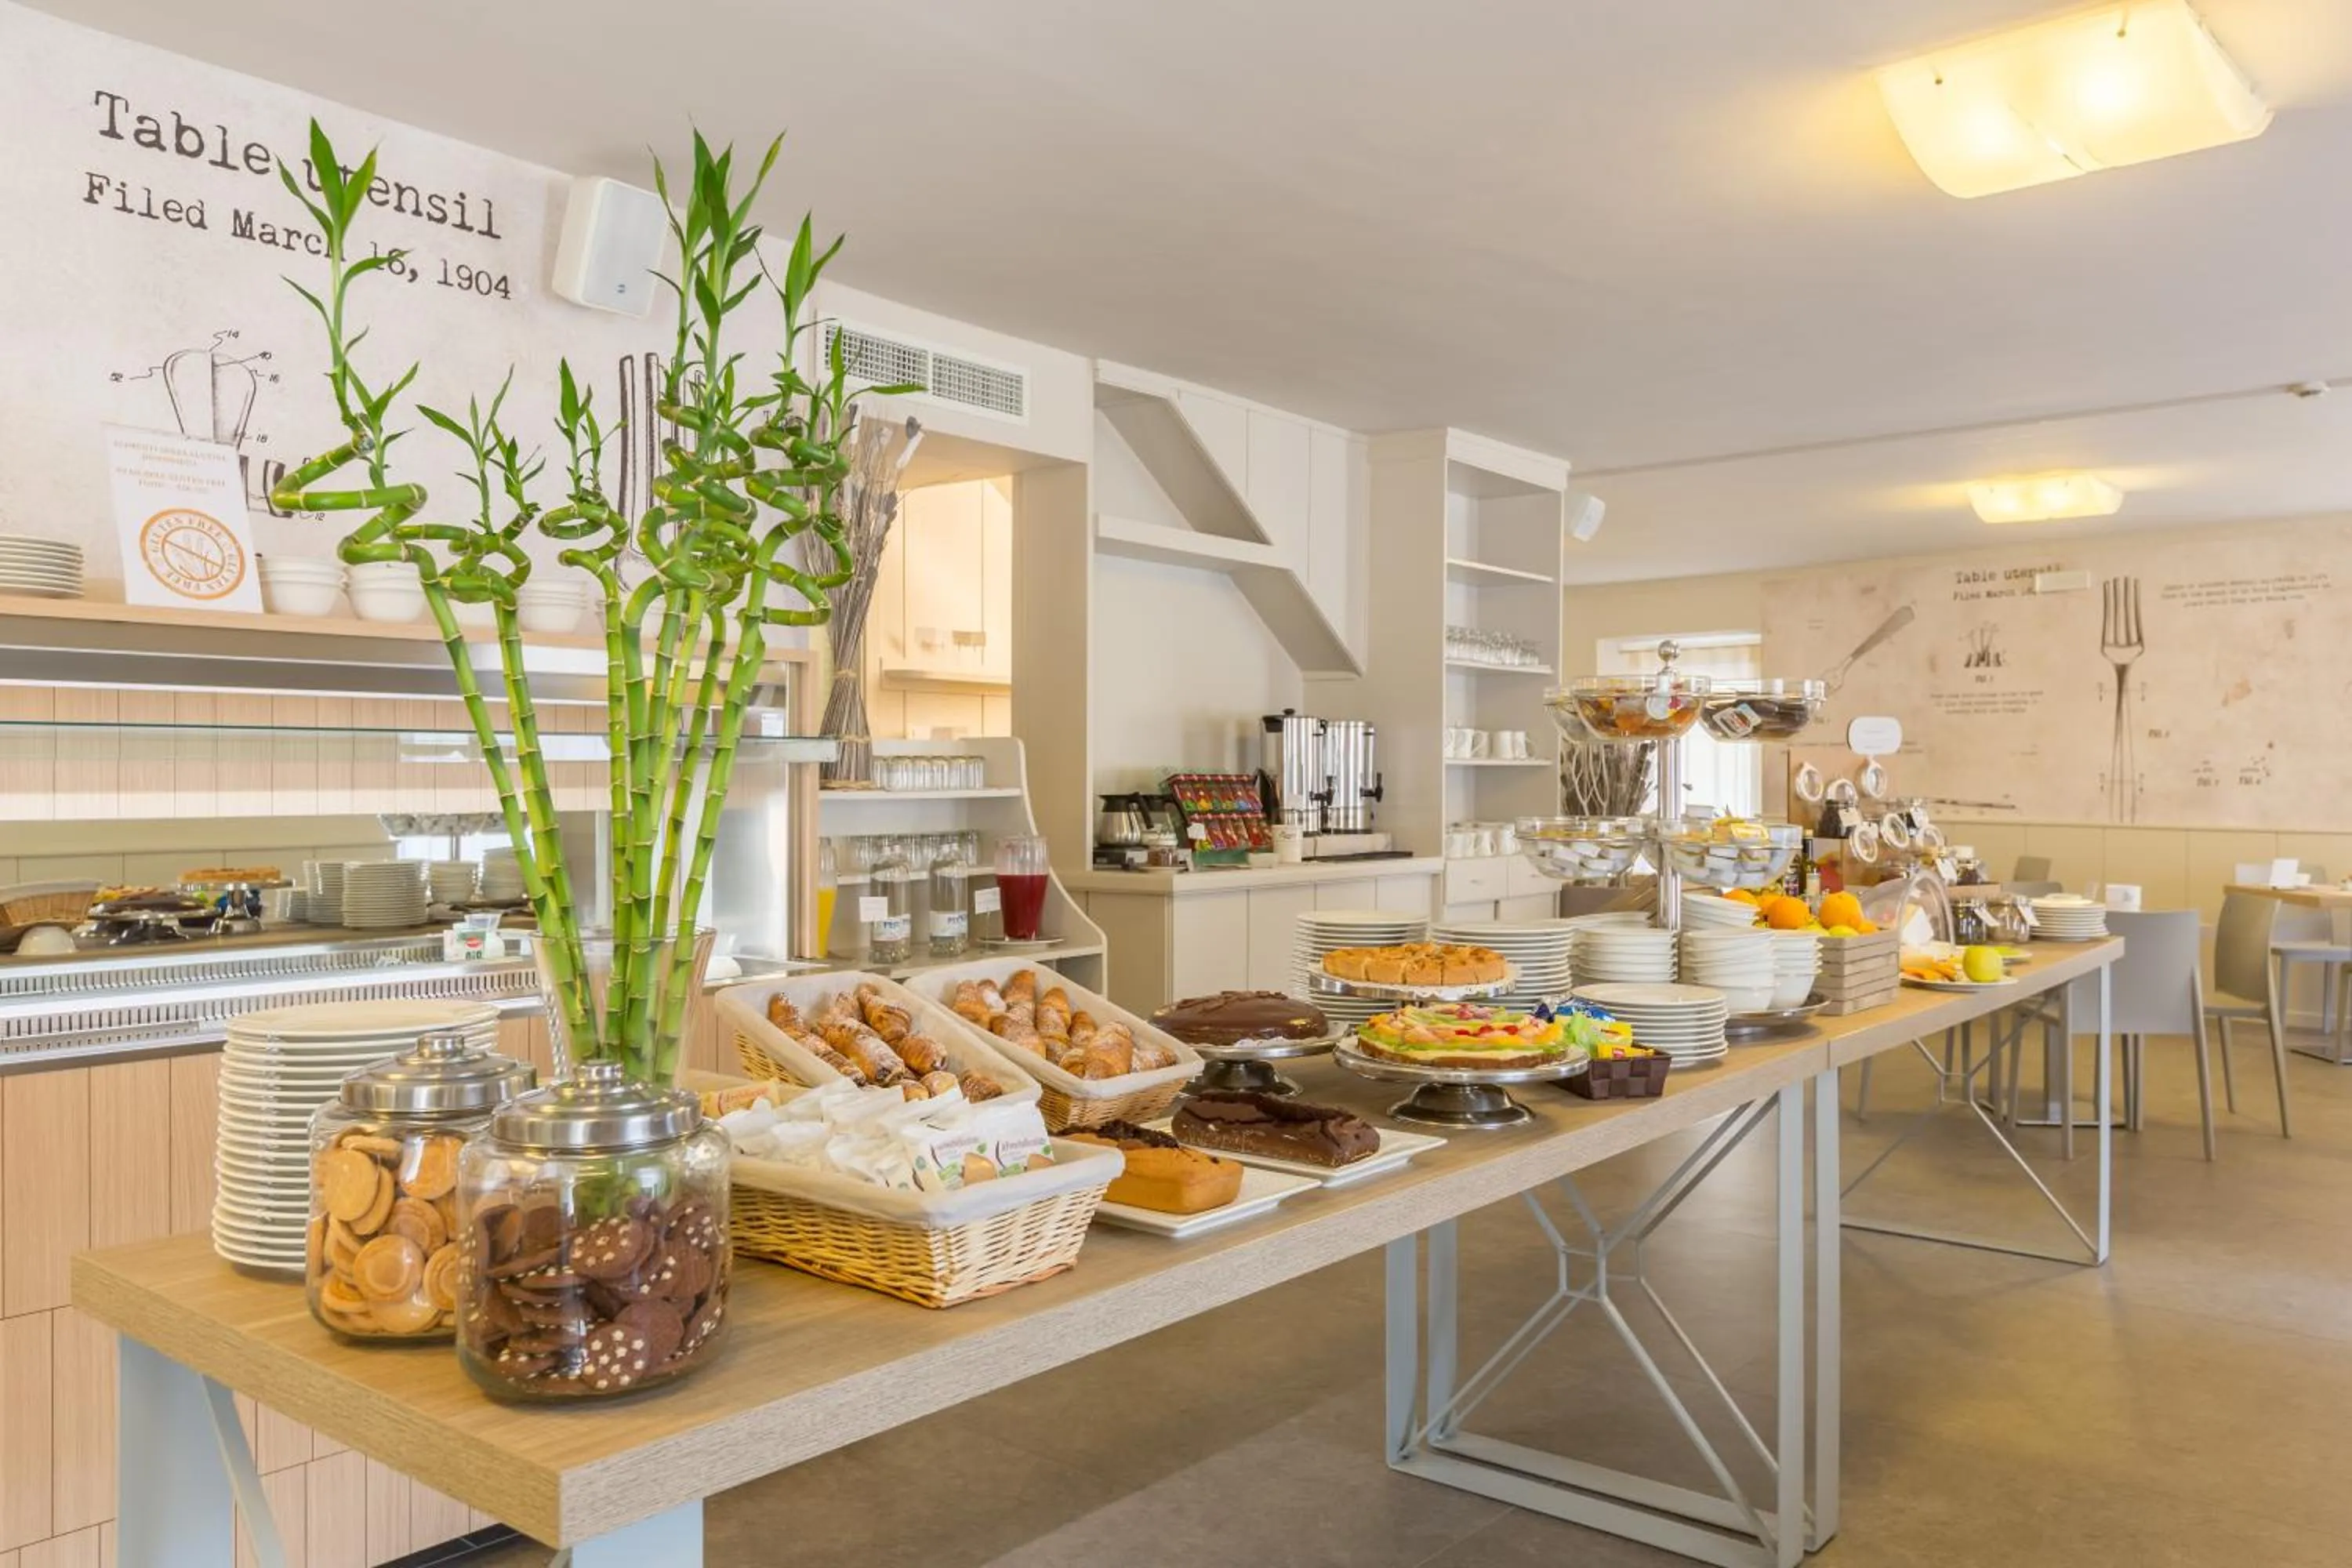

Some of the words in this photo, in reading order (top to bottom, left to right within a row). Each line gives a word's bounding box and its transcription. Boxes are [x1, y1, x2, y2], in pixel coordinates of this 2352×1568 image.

[94, 90, 270, 175] Table
[82, 172, 208, 230] Filed
[231, 208, 346, 262] Marc
[437, 259, 511, 300] 1904
